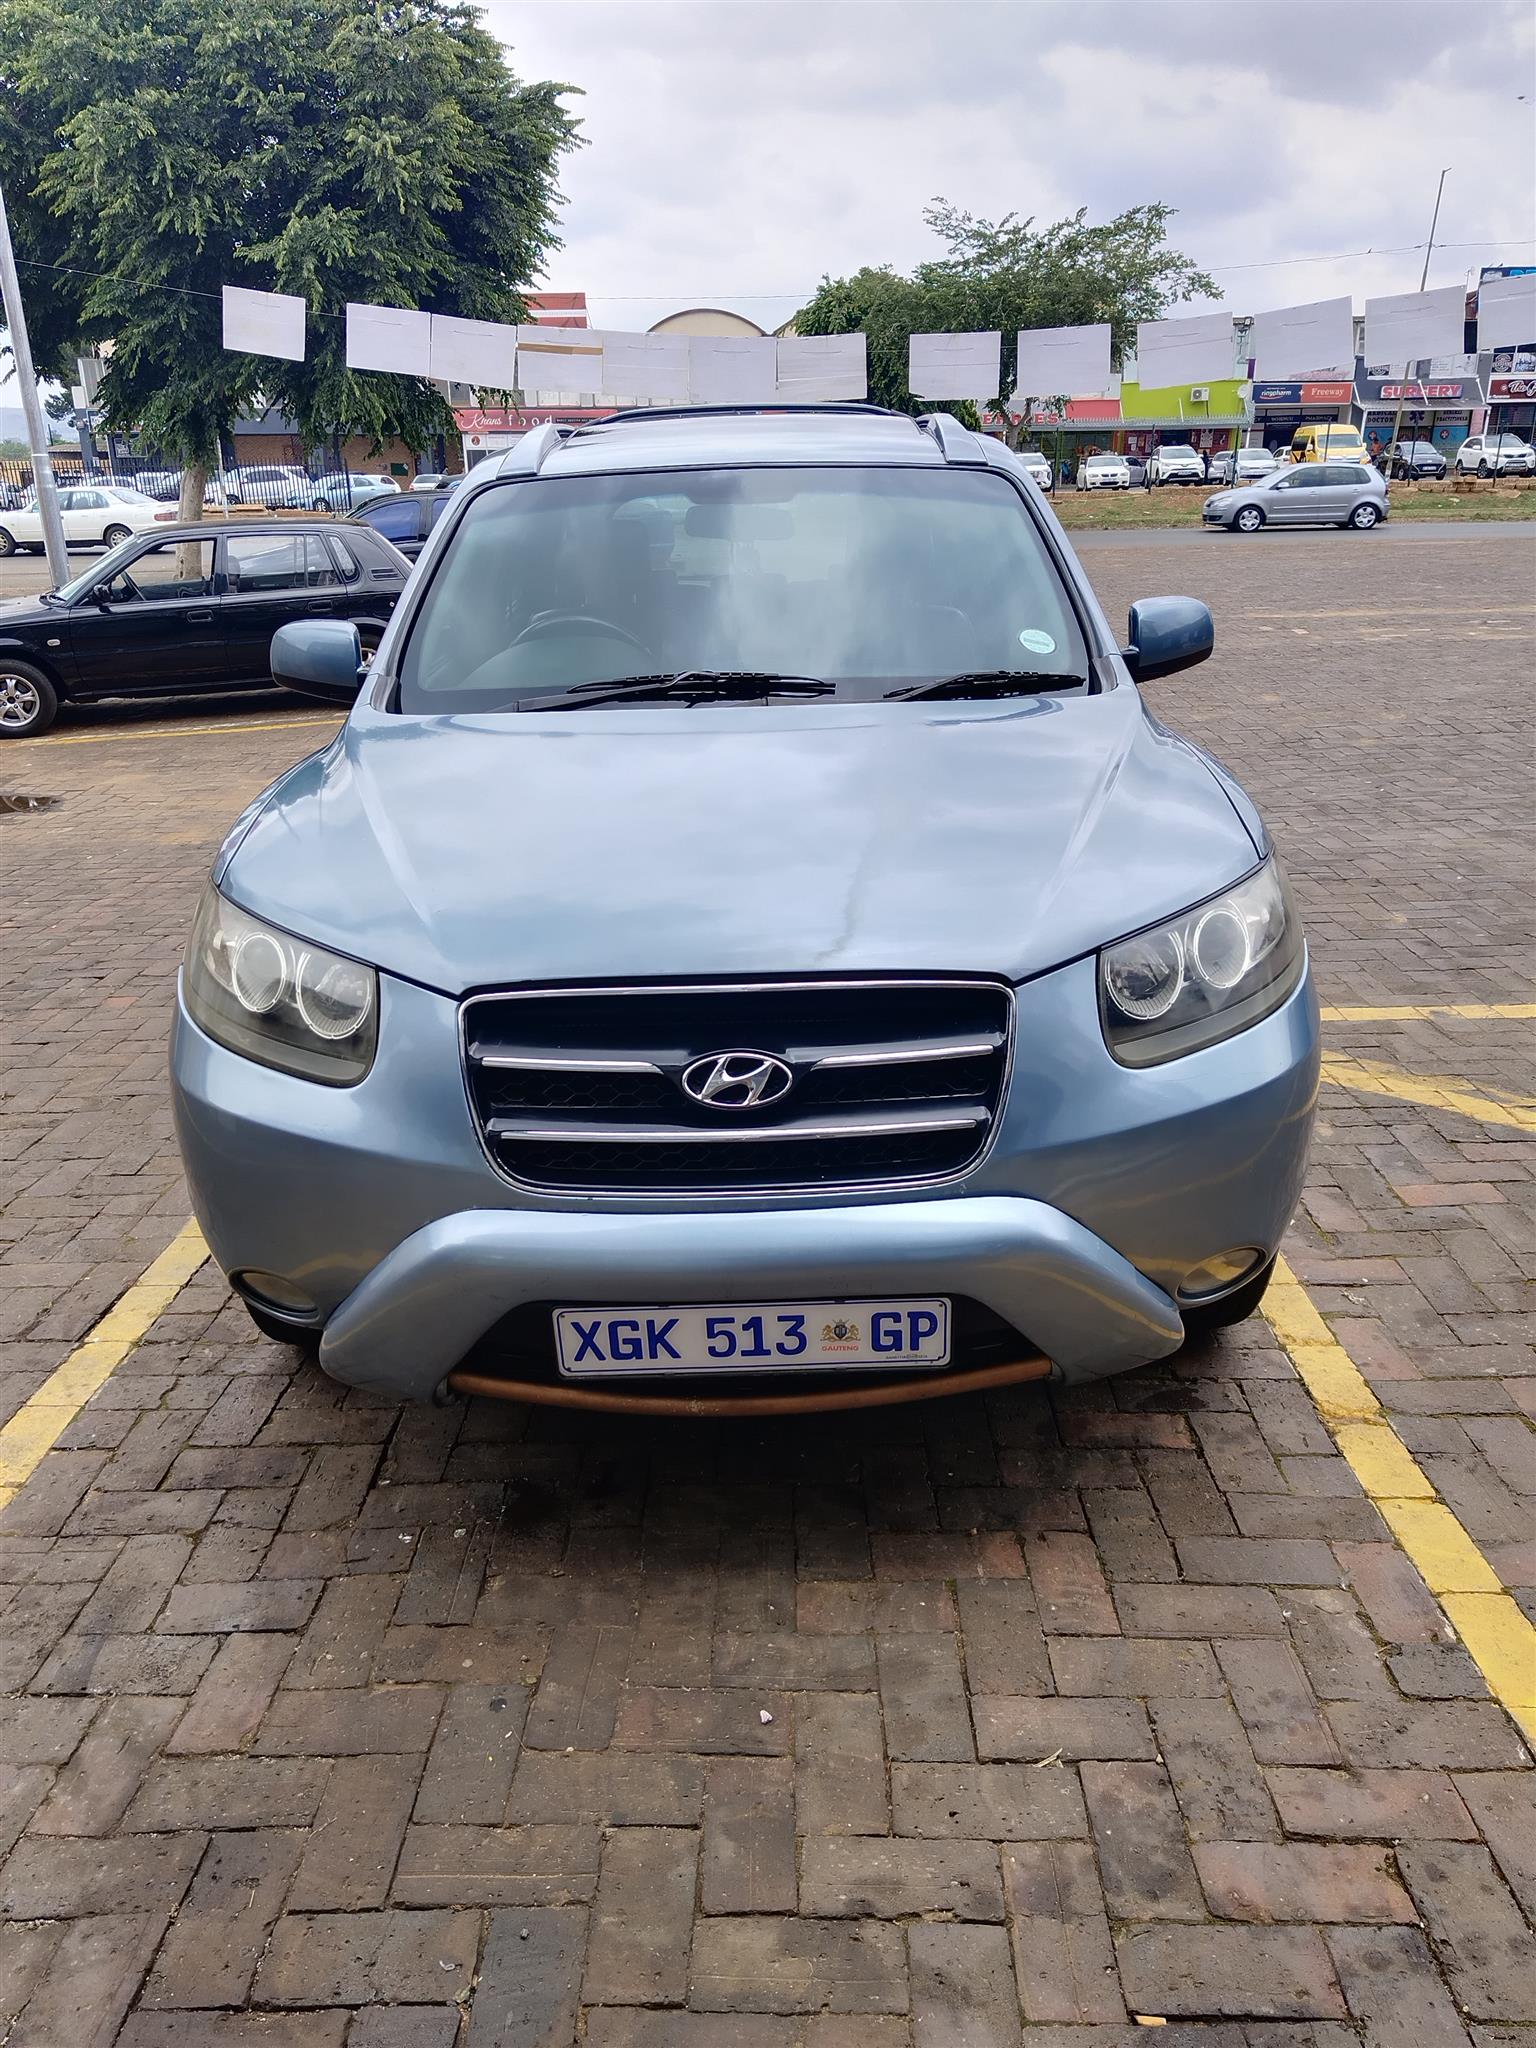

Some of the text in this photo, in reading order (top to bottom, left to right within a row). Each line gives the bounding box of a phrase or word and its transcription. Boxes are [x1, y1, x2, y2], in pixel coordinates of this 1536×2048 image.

[1311, 388, 1344, 397] Freeway
[1382, 386, 1462, 398] SURGERY
[570, 1311, 938, 1362] XGK 513 GP
[821, 1344, 859, 1352] GAUTENG
